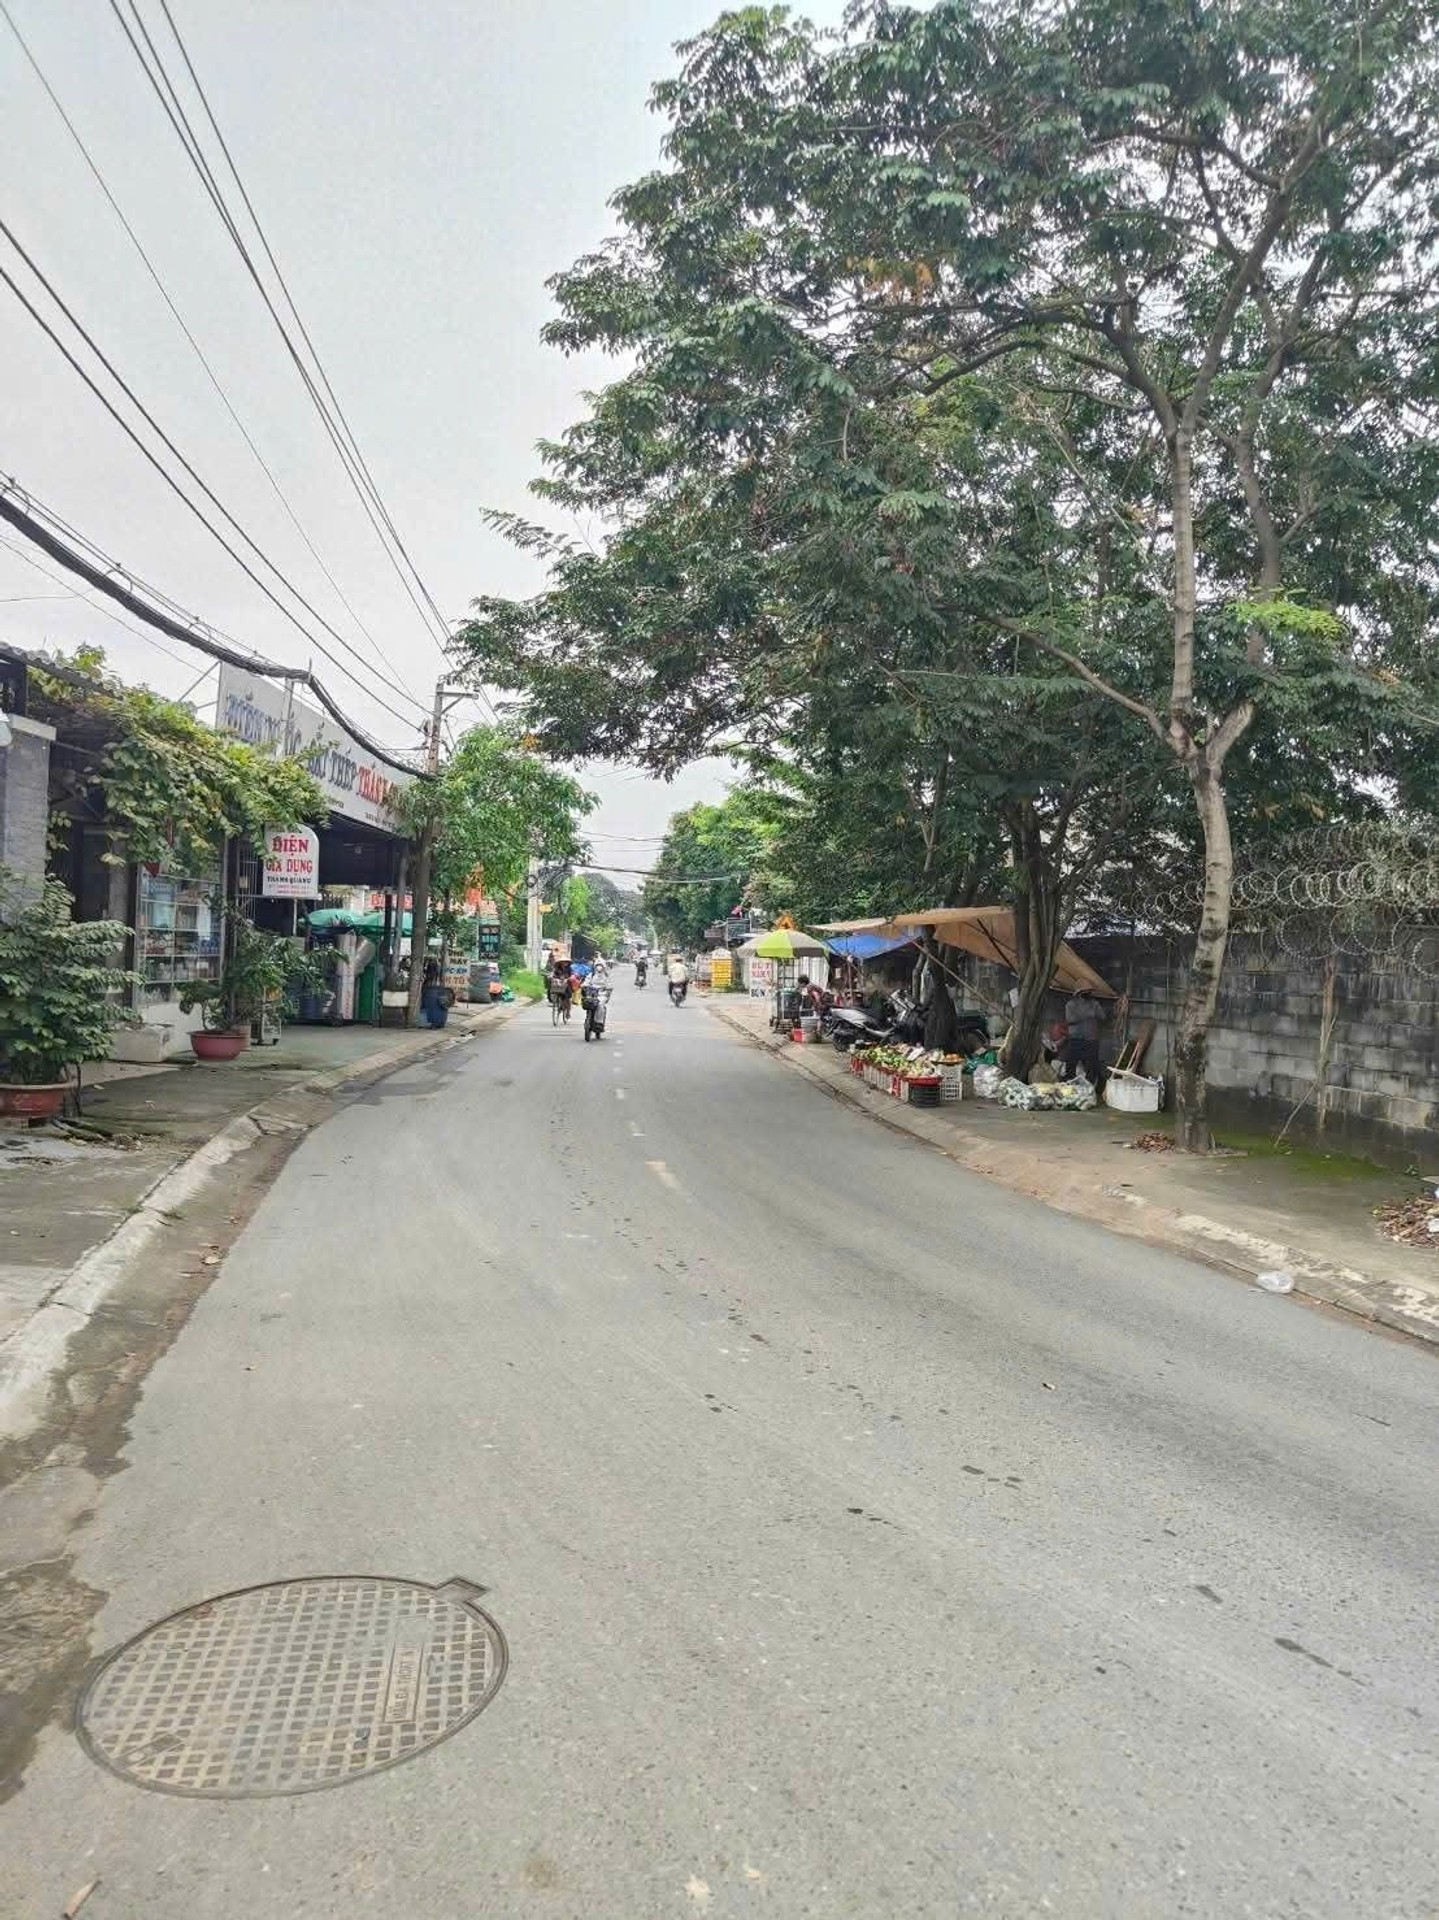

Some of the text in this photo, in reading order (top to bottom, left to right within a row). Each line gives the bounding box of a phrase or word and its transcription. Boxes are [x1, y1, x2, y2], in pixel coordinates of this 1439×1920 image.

[272, 834, 309, 856] ĐIỆN
[265, 858, 313, 875] GIA DỤNG
